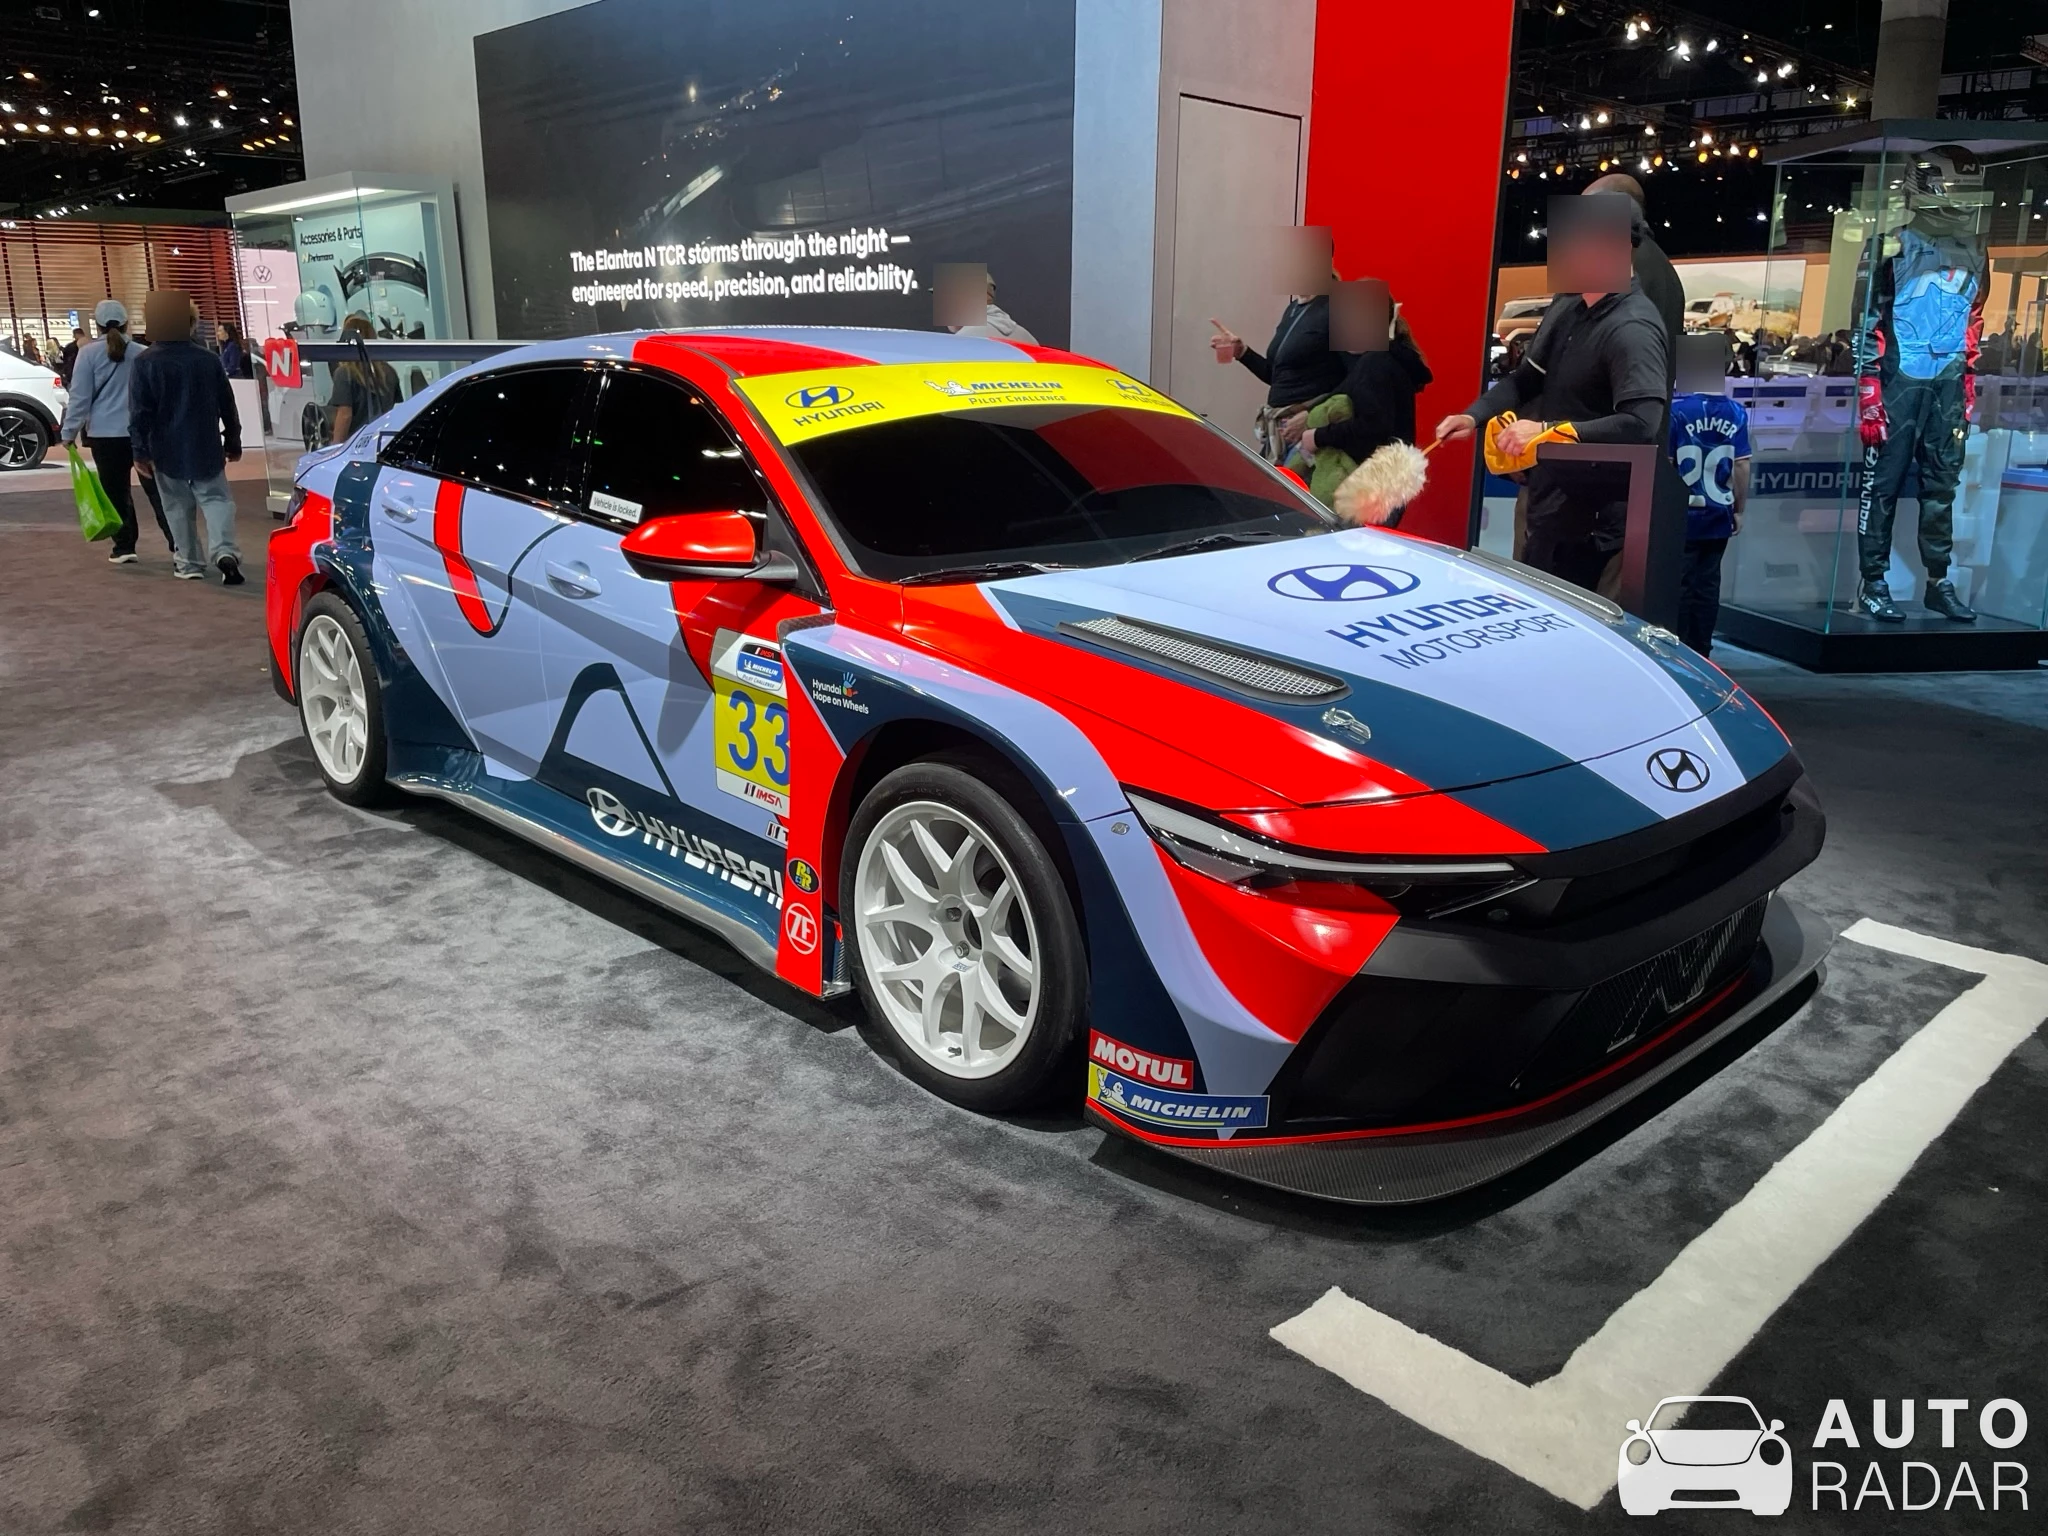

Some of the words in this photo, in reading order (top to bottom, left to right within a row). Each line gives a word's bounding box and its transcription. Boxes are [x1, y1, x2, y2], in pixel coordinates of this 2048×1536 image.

[300, 229, 336, 246] Accessories
[337, 227, 342, 241] &
[343, 226, 362, 240] Parts
[570, 251, 595, 272] The
[595, 249, 643, 271] Elantra
[644, 246, 656, 267] N
[657, 244, 687, 267] TCR
[688, 244, 740, 265] storms
[741, 234, 806, 264] through
[807, 231, 838, 257] the
[839, 227, 889, 259] night
[571, 278, 643, 306] engineered
[643, 278, 664, 300] for
[665, 276, 713, 302] speed,
[714, 270, 790, 302] precision,
[790, 268, 826, 295] and
[827, 263, 918, 295] reliability.
[969, 381, 1063, 390] MICHELIN
[793, 401, 885, 426] HYUNDAI
[1685, 417, 1738, 439] PALMER
[1676, 444, 1736, 507] 20
[1750, 472, 1860, 489] HYUNDAI
[593, 497, 612, 511] Vehicle
[612, 502, 618, 511] is
[618, 504, 637, 518] locked.
[1858, 471, 1875, 535] HYUNDAI
[1325, 593, 1539, 649] HYUNDAI
[1380, 613, 1576, 670] MOTORSPORT
[752, 663, 779, 676] MICHELIN
[812, 678, 842, 695] Hyundai
[812, 690, 832, 704] Hope
[832, 697, 842, 706] on
[842, 698, 869, 714] Wheels
[728, 689, 790, 787] 33
[755, 788, 783, 809] IMSA
[637, 810, 784, 911] HYUNDAI
[789, 911, 814, 946] ZF
[1093, 1037, 1188, 1085] MOTUL
[1130, 1094, 1252, 1119] MICHELIN
